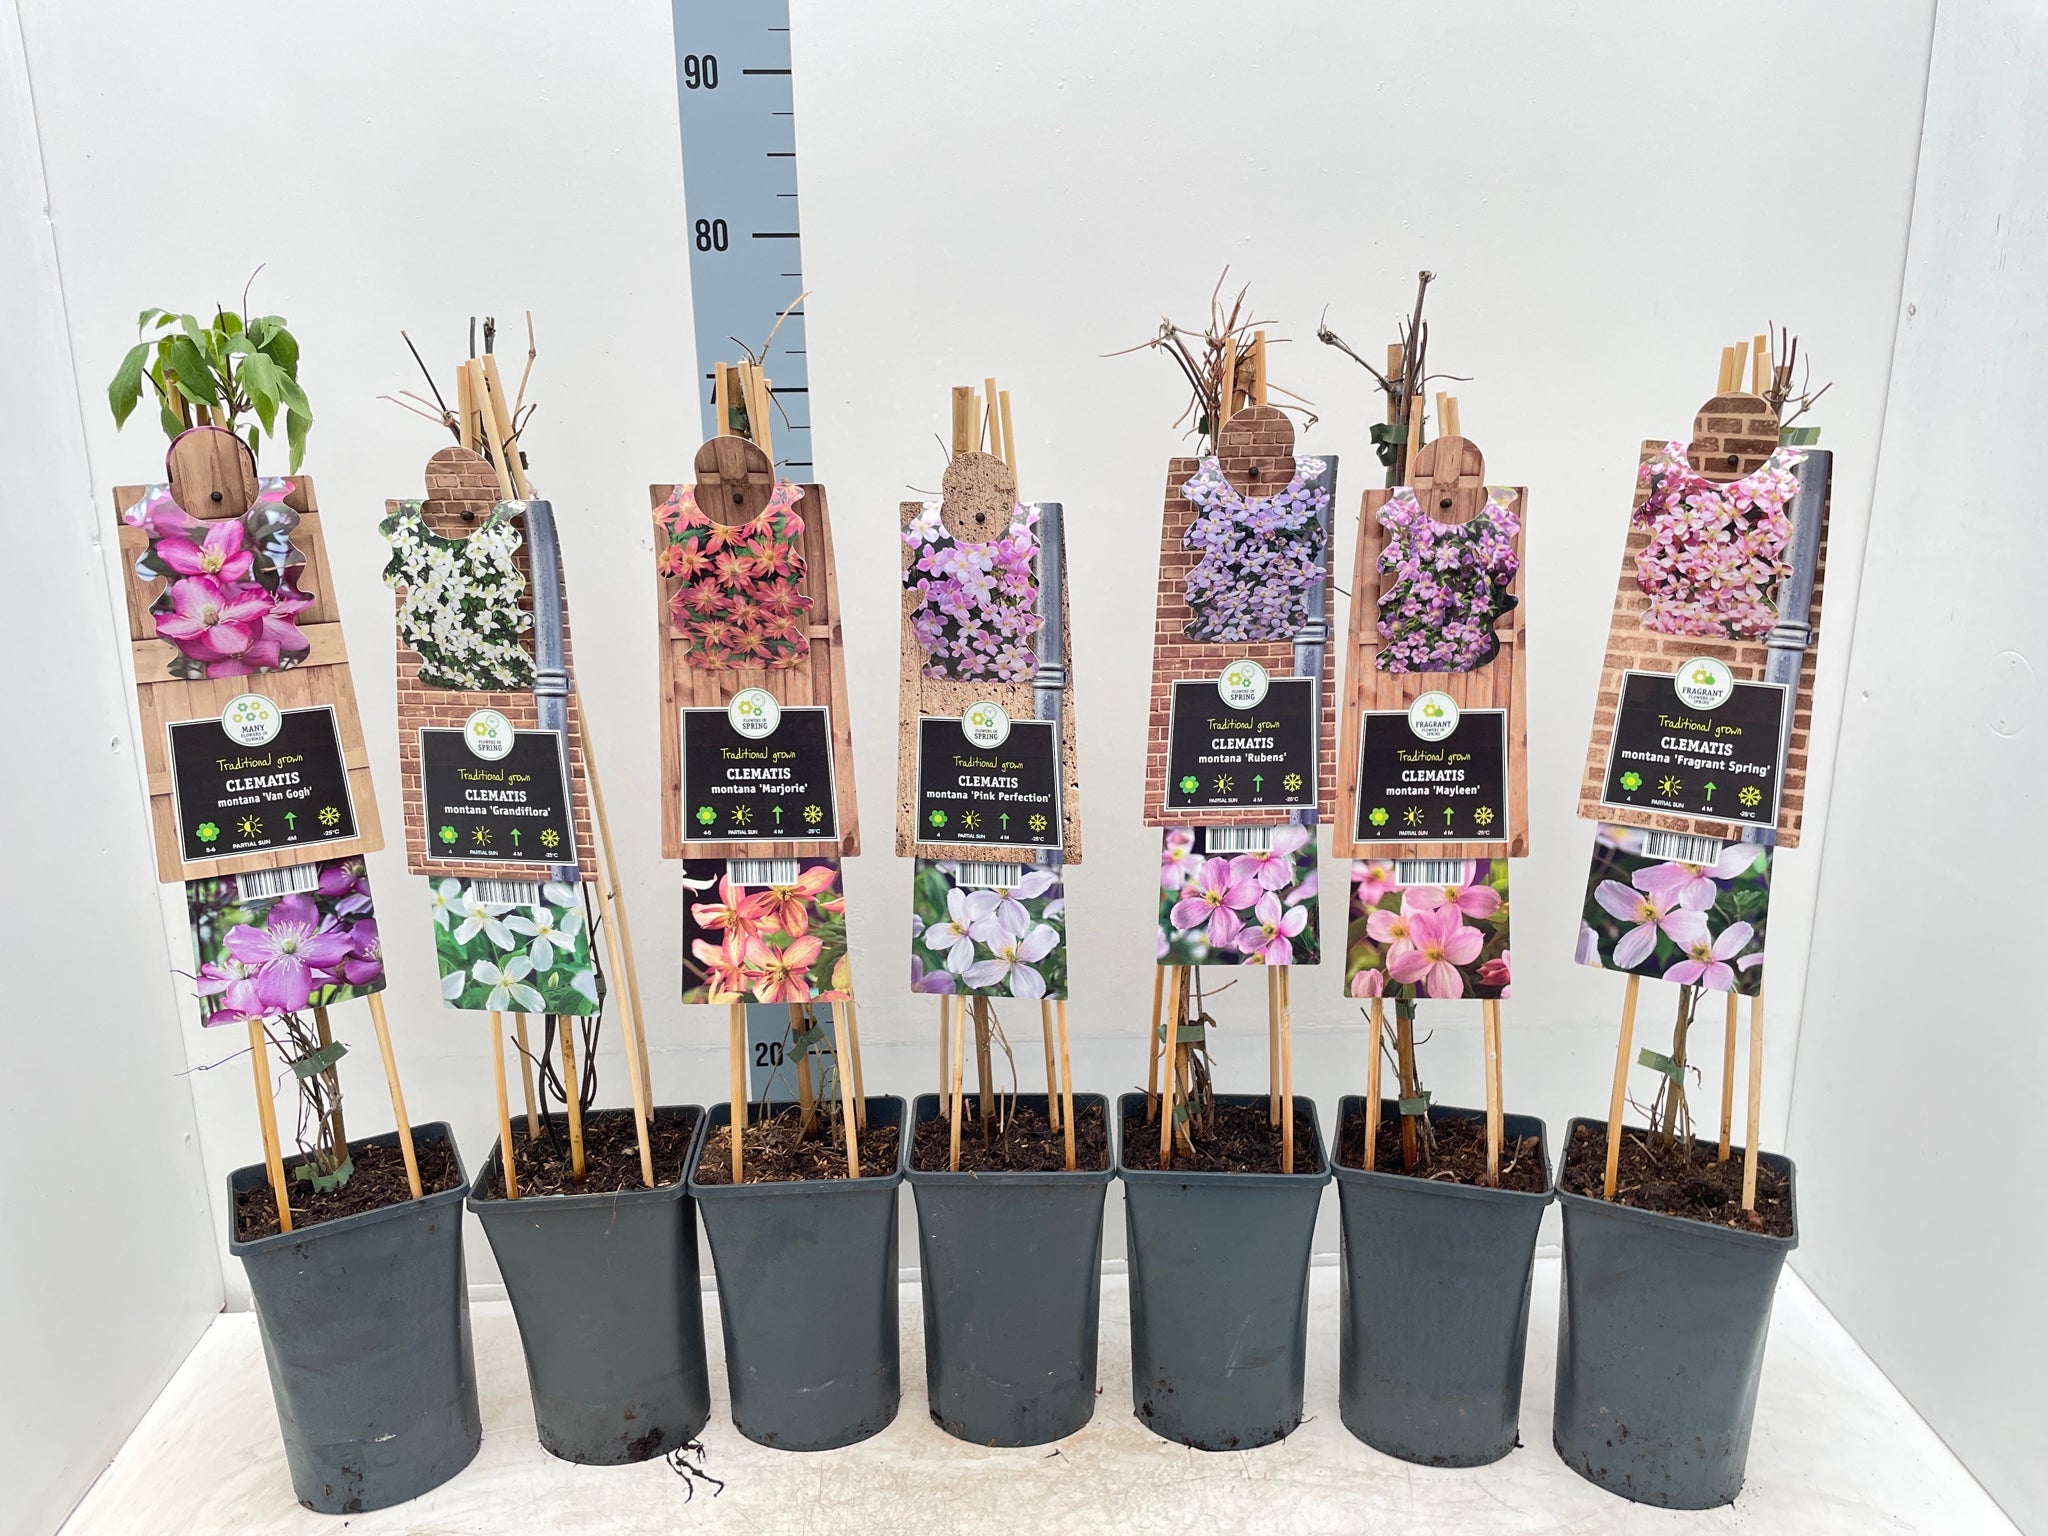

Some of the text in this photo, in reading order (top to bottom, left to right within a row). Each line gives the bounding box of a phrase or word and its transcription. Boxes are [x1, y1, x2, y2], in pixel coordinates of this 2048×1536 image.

[684, 54, 718, 90] 90
[696, 218, 728, 252] 80
[1682, 687, 1723, 697] FRAGRANT
[242, 724, 265, 733] MANY
[1207, 717, 1279, 733] Traditional grown
[1659, 715, 1741, 737] Traditional grown
[1212, 737, 1274, 749] CLEMATIS
[1661, 737, 1733, 756] CLEMATIS
[720, 746, 795, 763] Traditional grown
[1199, 752, 1286, 763] montana 'Rubens'
[1397, 749, 1471, 765] Traditional grown
[216, 753, 303, 771] Traditional grown
[953, 756, 1023, 772] Traditional grown
[1622, 750, 1770, 777] montana 'Fragrant Spring'
[458, 769, 531, 785] Traditional grown
[727, 768, 791, 779] CLEMATIS
[1402, 770, 1465, 781] CLEMATIS
[226, 772, 300, 792] CLEMATIS
[958, 776, 1018, 788] CLEMATIS
[466, 789, 527, 802] CLEMATIS
[712, 784, 807, 795] montana 'Marjorie'
[927, 791, 1050, 802] montana 'Pink Perfection'
[1386, 785, 1480, 796] montana 'Mayleen'
[218, 786, 313, 808] montana 'Van Gogh'
[1651, 799, 1672, 807] PARTIAL
[445, 806, 551, 816] montana 'Grandiflora'
[233, 841, 257, 849] PARTIAL
[756, 1042, 784, 1066] 20
